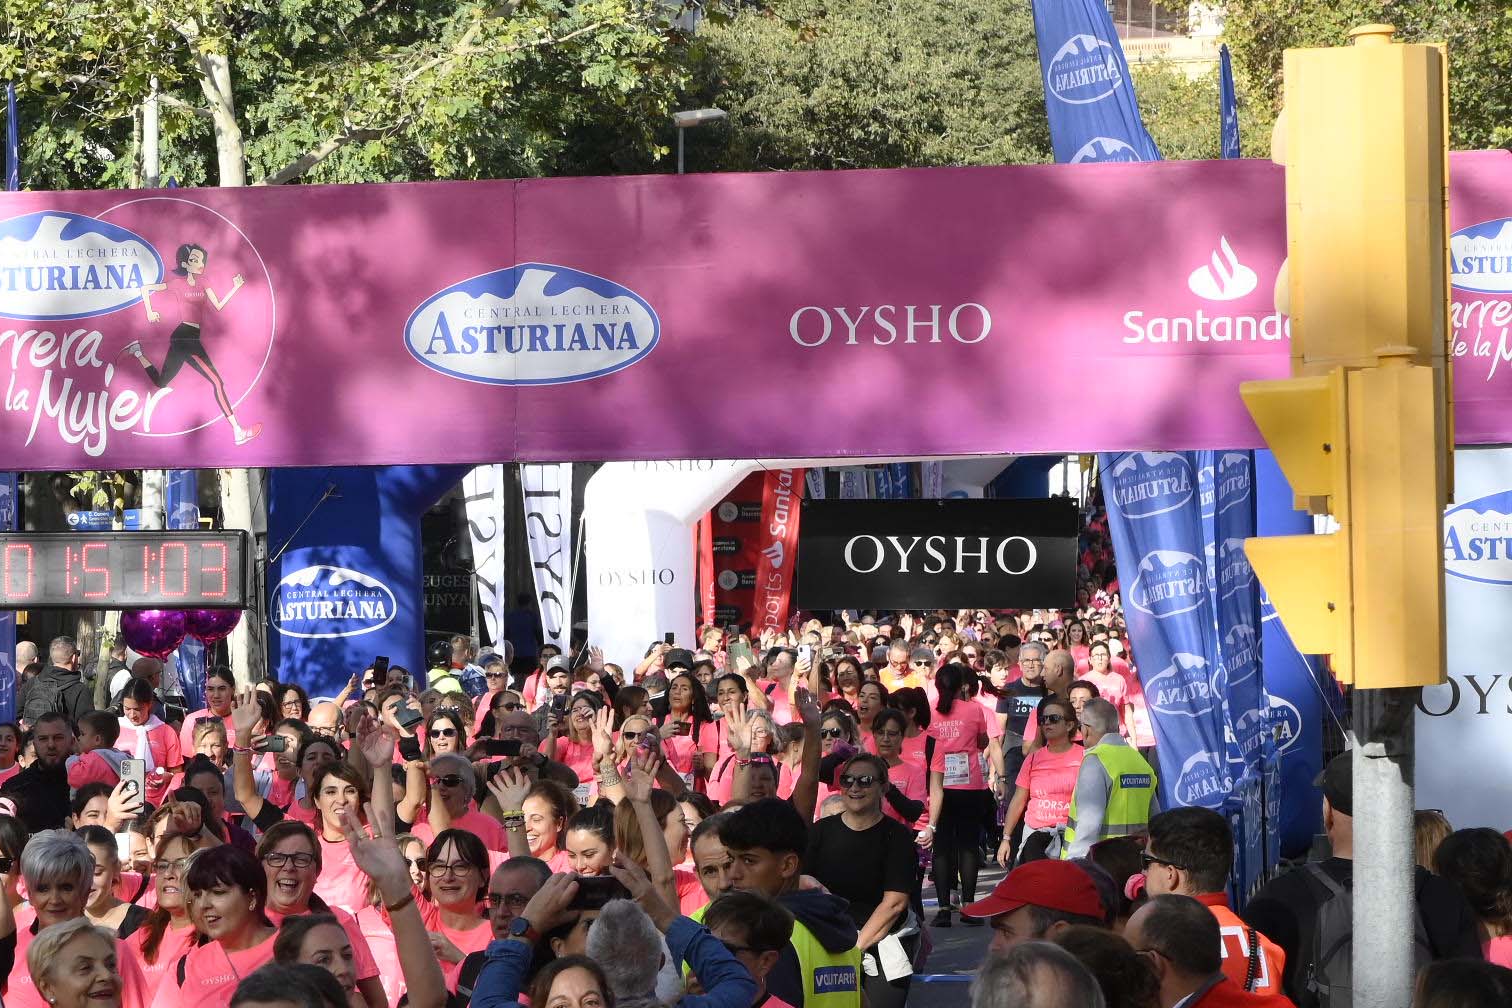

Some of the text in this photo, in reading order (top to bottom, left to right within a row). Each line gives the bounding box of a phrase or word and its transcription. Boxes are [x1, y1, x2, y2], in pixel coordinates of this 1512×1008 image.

[464, 302, 632, 320] CENTRAL LECHERA
[788, 303, 992, 347] OYSHO
[424, 310, 640, 355] ASTURIANA
[1487, 326, 1512, 382] M
[5, 370, 29, 411] la
[25, 362, 174, 457] Mujer
[844, 534, 1037, 575] OYSHO
[599, 567, 675, 586] OYSHO
[274, 597, 387, 623] ASTURIANA
[286, 589, 383, 599] CENTRAL LECHERA
[201, 974, 236, 985] OYSHO
